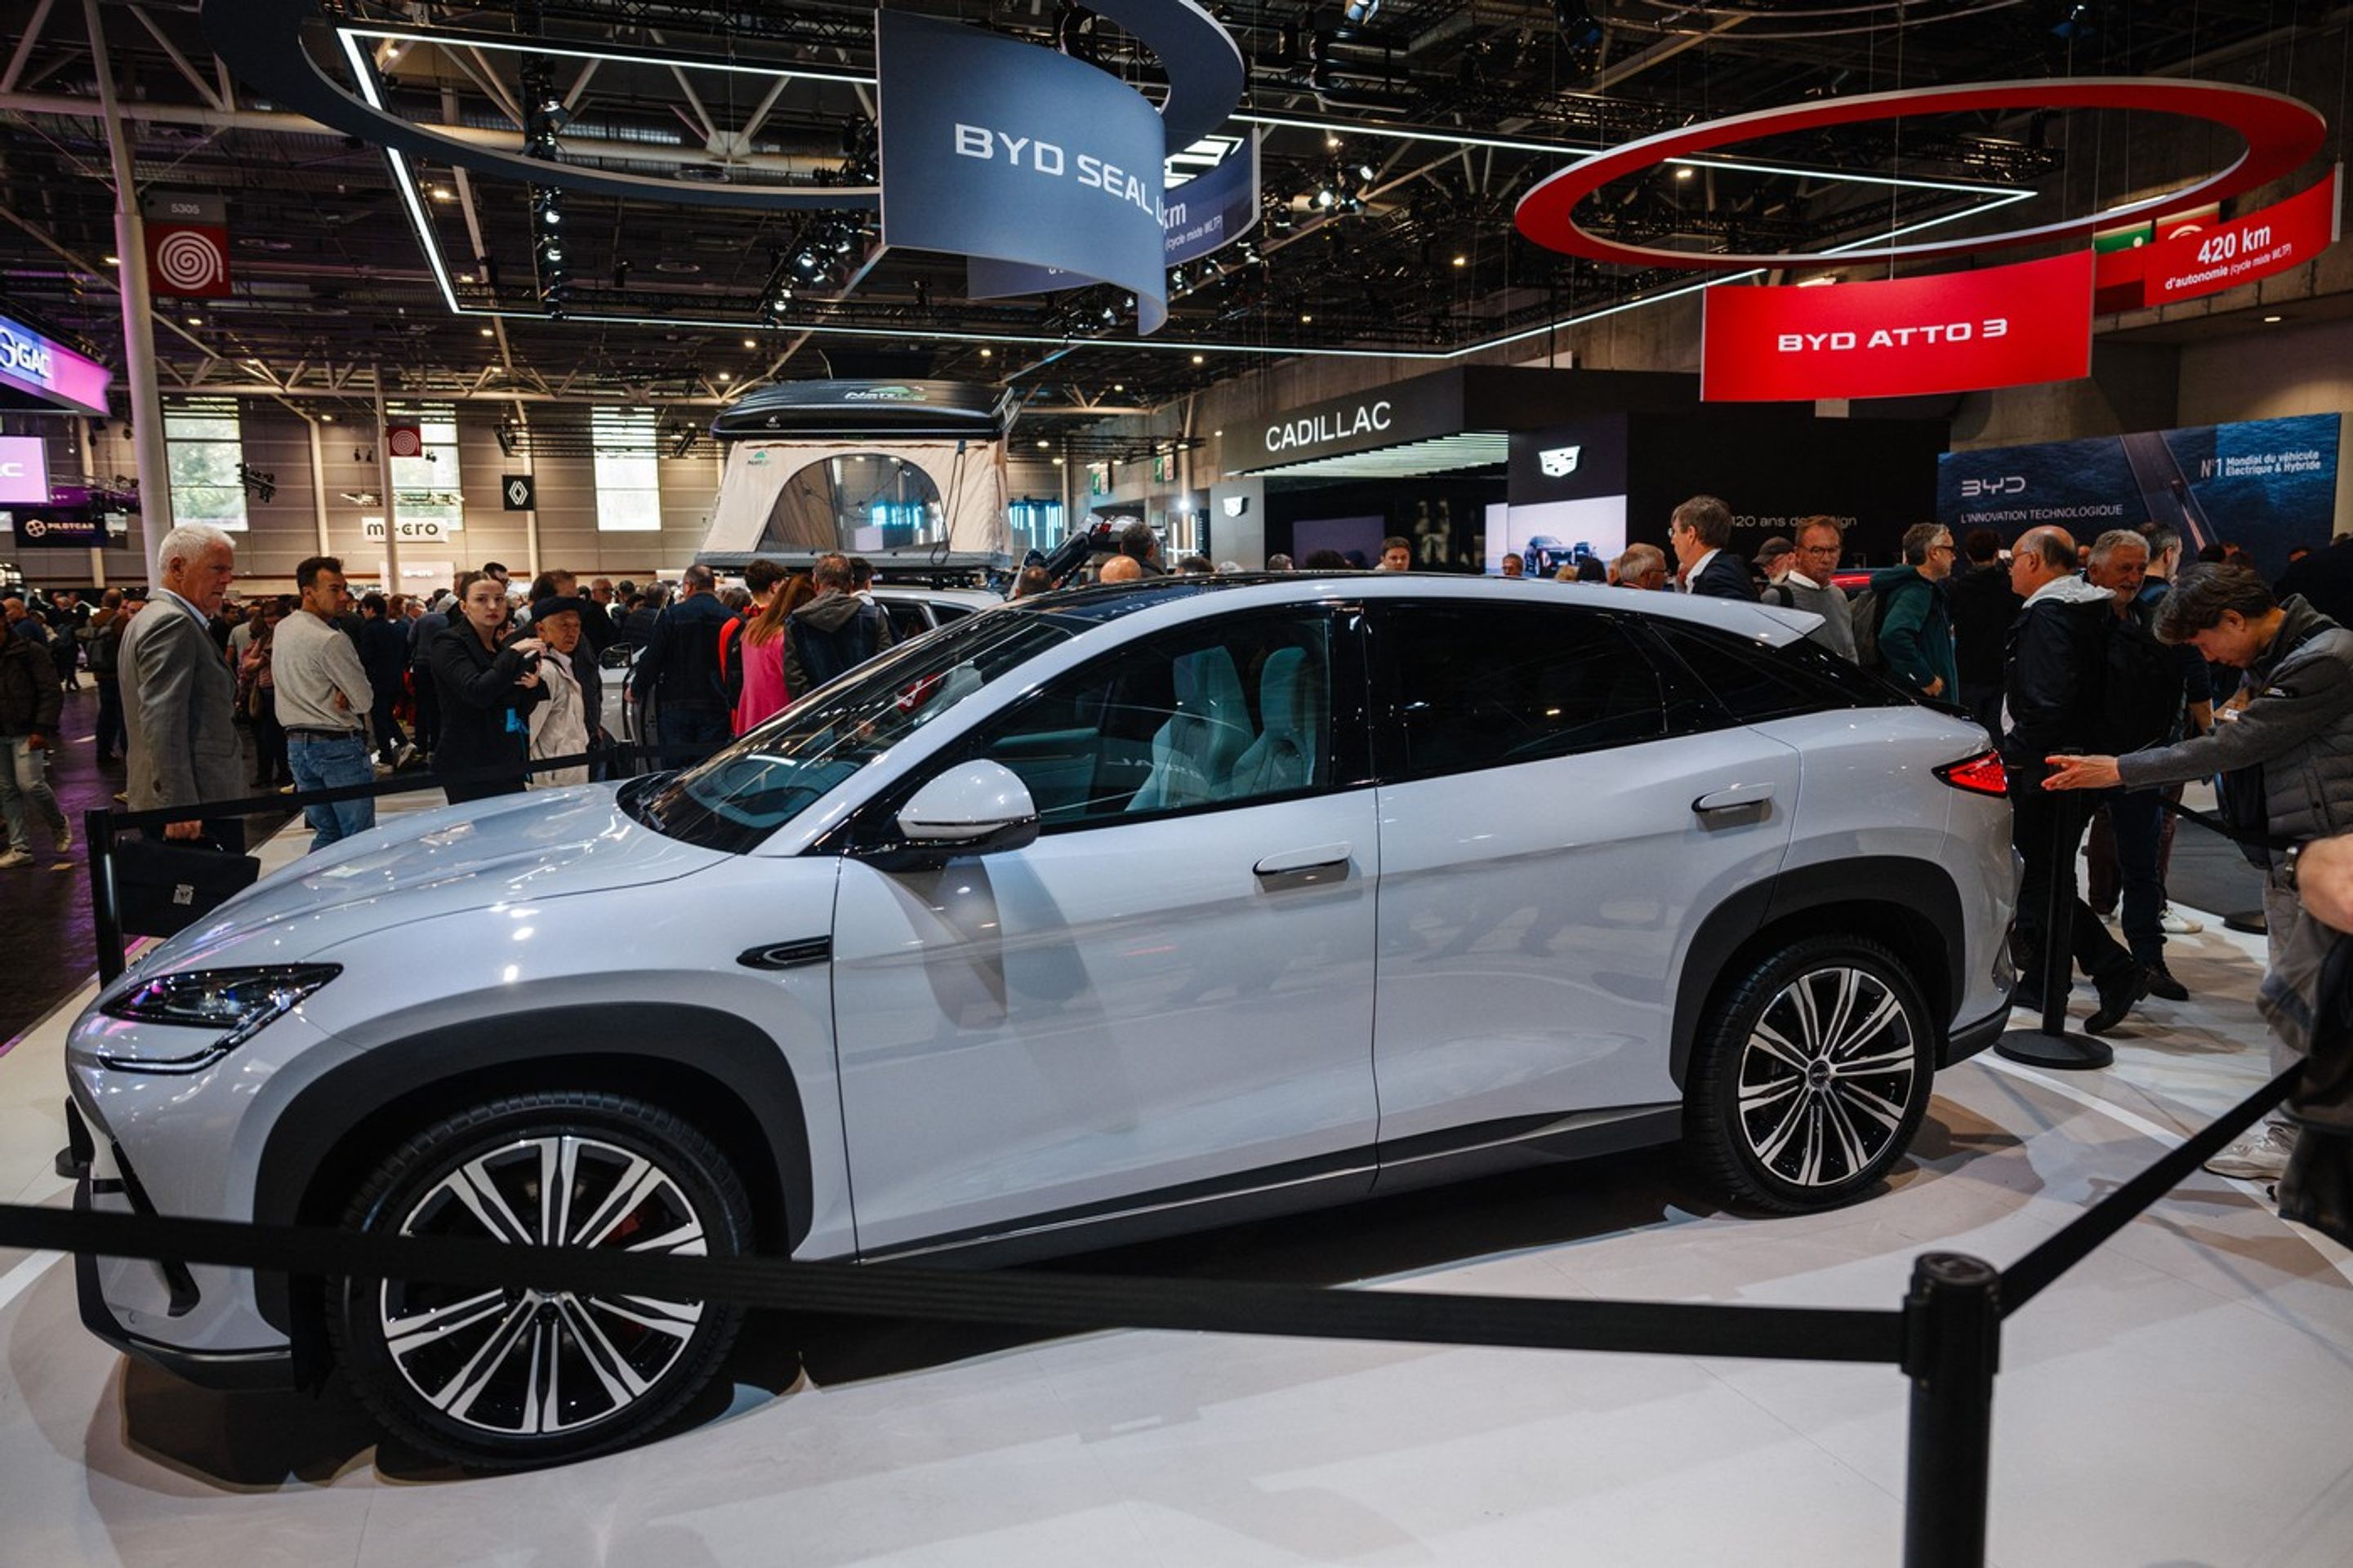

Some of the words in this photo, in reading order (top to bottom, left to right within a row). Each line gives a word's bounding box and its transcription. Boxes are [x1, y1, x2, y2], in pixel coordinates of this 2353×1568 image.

[955, 123, 1064, 176] BYD
[1076, 154, 1153, 216] SEAL
[2197, 231, 2236, 265] 420
[2242, 225, 2271, 254] km
[2165, 266, 2229, 291] d'autonomie
[1777, 332, 1856, 352] BYD
[1866, 322, 1972, 349] ATTO
[1981, 318, 2008, 339] 3
[18, 342, 52, 380] GAC
[1265, 401, 1392, 452] CADILLAC
[2226, 454, 2263, 469] Mondial
[2284, 460, 2322, 474] Hybride
[1961, 475, 2026, 497] BYD
[1759, 516, 1786, 528] ans
[1960, 510, 2027, 524] L'INNOVATION
[2029, 504, 2123, 519] TECHNOLOGIQUE
